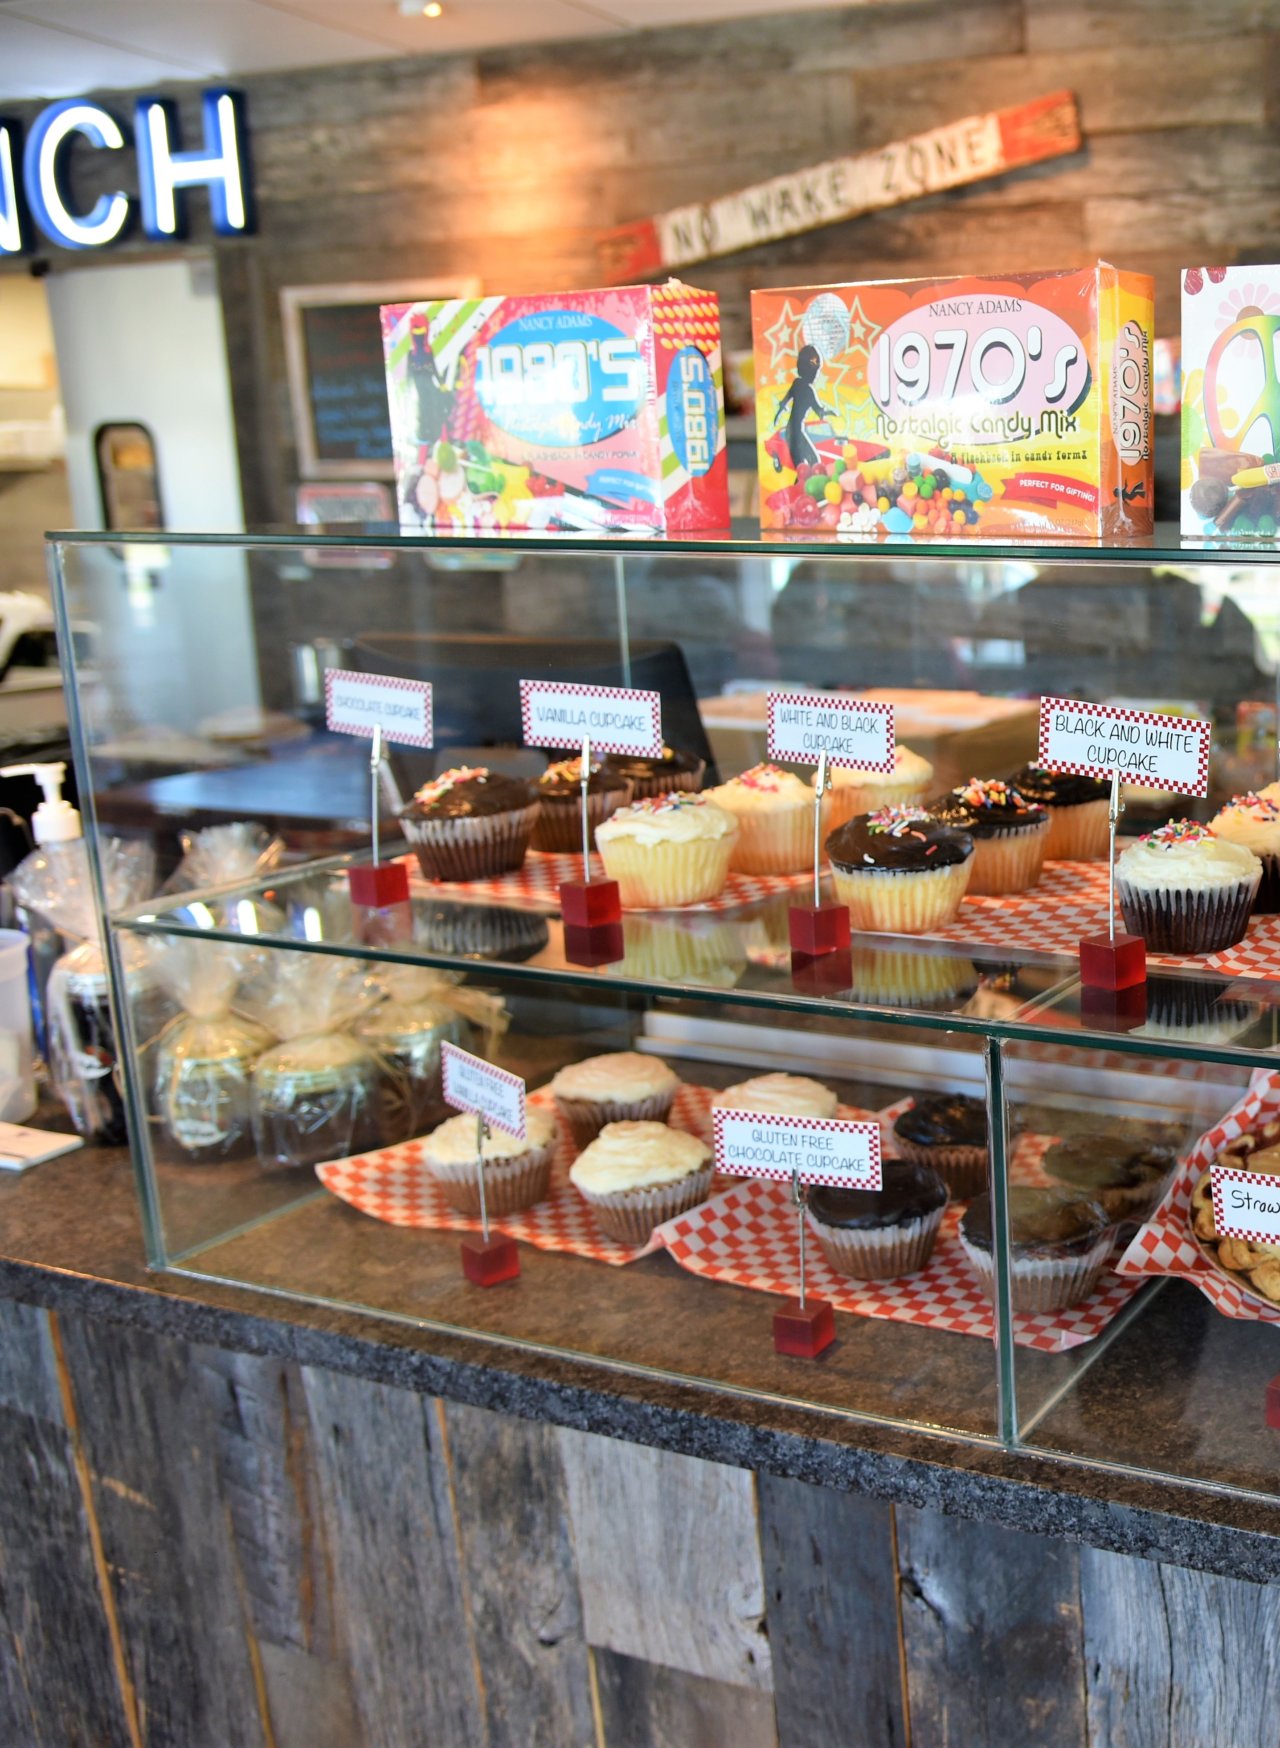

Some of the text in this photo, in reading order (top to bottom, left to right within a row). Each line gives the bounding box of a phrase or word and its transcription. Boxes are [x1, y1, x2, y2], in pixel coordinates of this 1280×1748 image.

[672, 123, 988, 253] NO WAKE ZONE
[929, 301, 974, 317] NANCY
[519, 315, 555, 332] NANCY
[475, 337, 642, 404] 1980'S
[878, 326, 1079, 407] 1970's
[1119, 326, 1142, 459] 1970's
[680, 355, 710, 473] 1980'S
[876, 409, 1077, 449] Nostalgic Candy Mix
[1020, 479, 1096, 503] PERFECT FOR GIFTING!
[536, 706, 646, 732] VANILLA CUPCAKE
[780, 708, 879, 734] WHITE AND BLACK
[802, 732, 854, 754] CUPCAKE
[1055, 714, 1194, 753] BLACK AND WHITE
[1087, 744, 1158, 773] CUPCAKE
[752, 1129, 835, 1151] GLUTEN FREE
[728, 1144, 866, 1172] CHOCOLATE CUPCAKE
